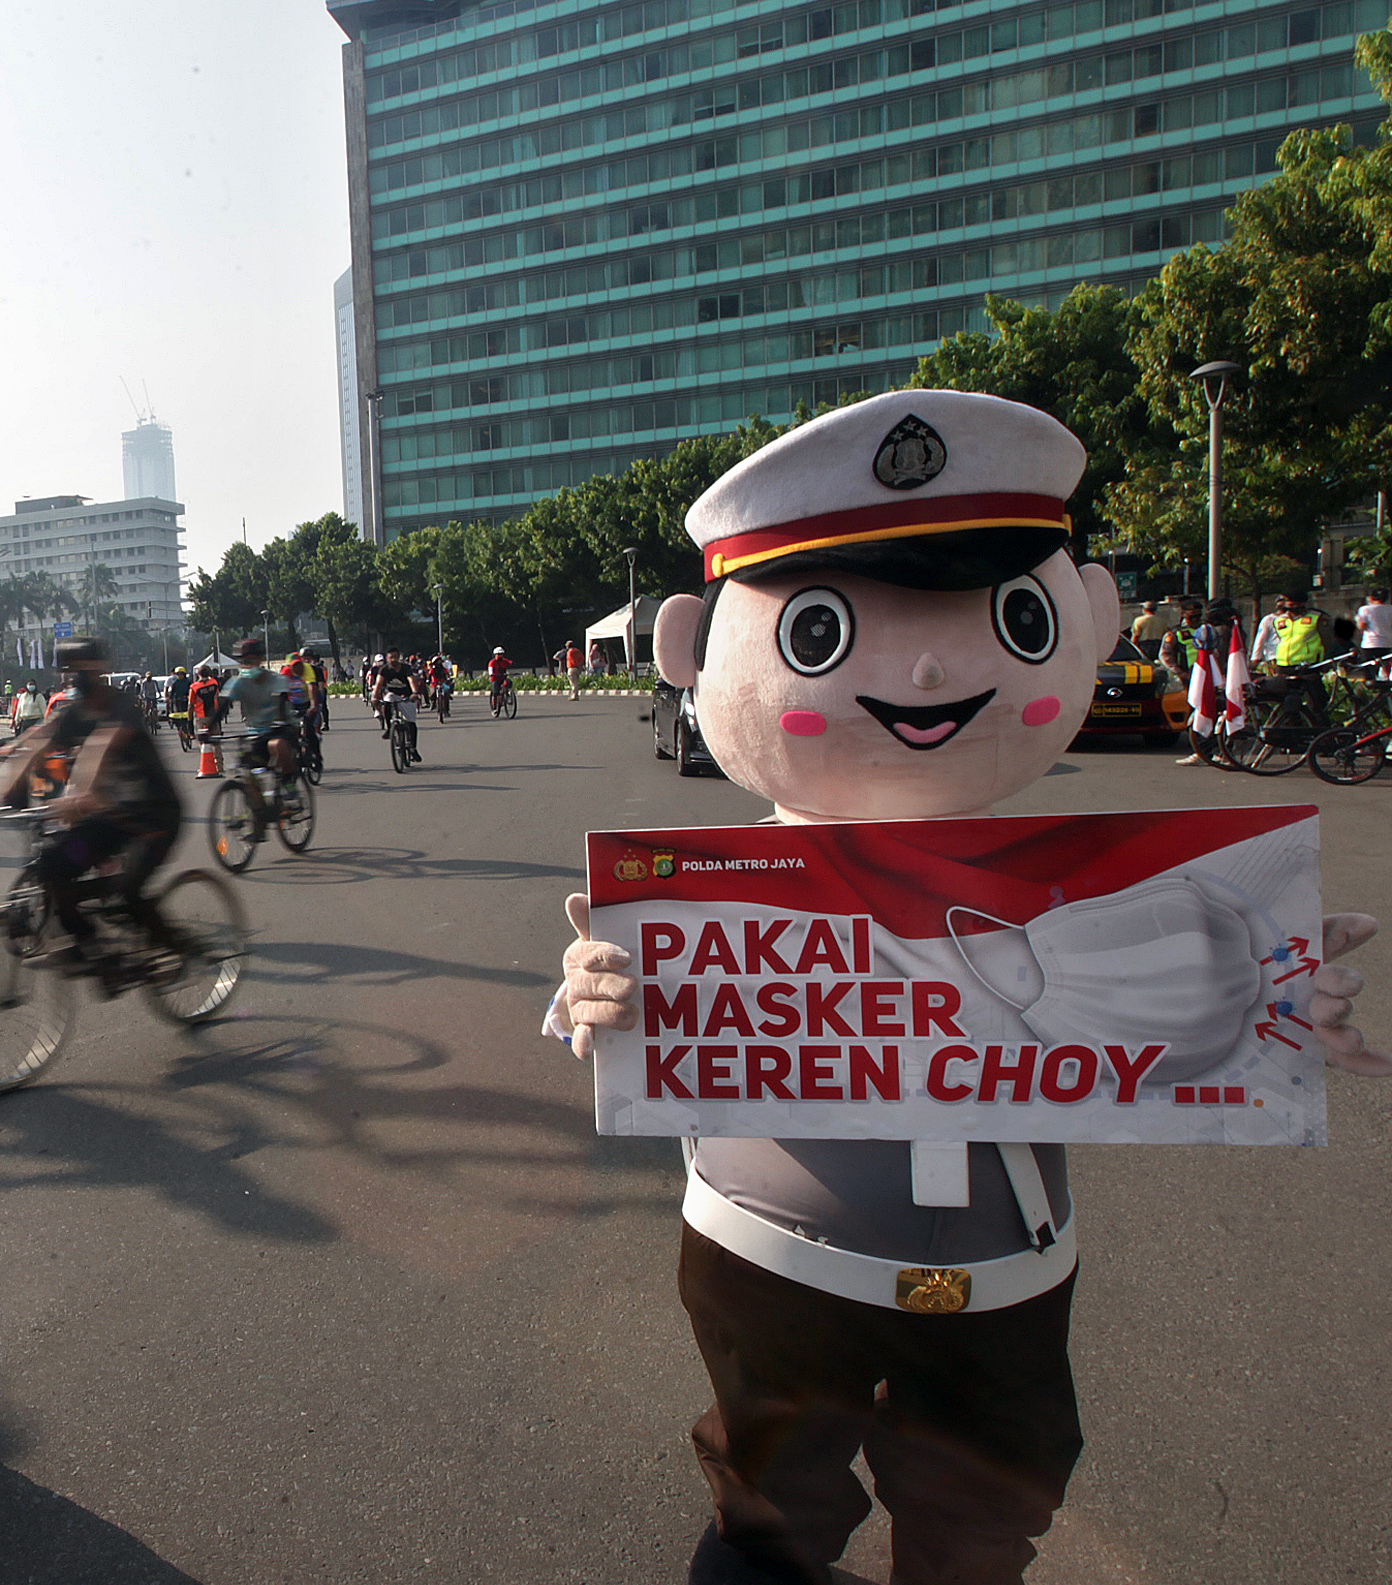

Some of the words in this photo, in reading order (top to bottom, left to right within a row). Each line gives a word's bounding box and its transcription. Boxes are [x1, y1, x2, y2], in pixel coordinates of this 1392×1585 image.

[682, 860, 723, 872] POLDA
[725, 859, 768, 870] METRO
[770, 858, 805, 869] JAYA
[639, 916, 873, 977] PAKAI
[642, 980, 967, 1039] MASKER
[644, 1044, 902, 1101] KEREN
